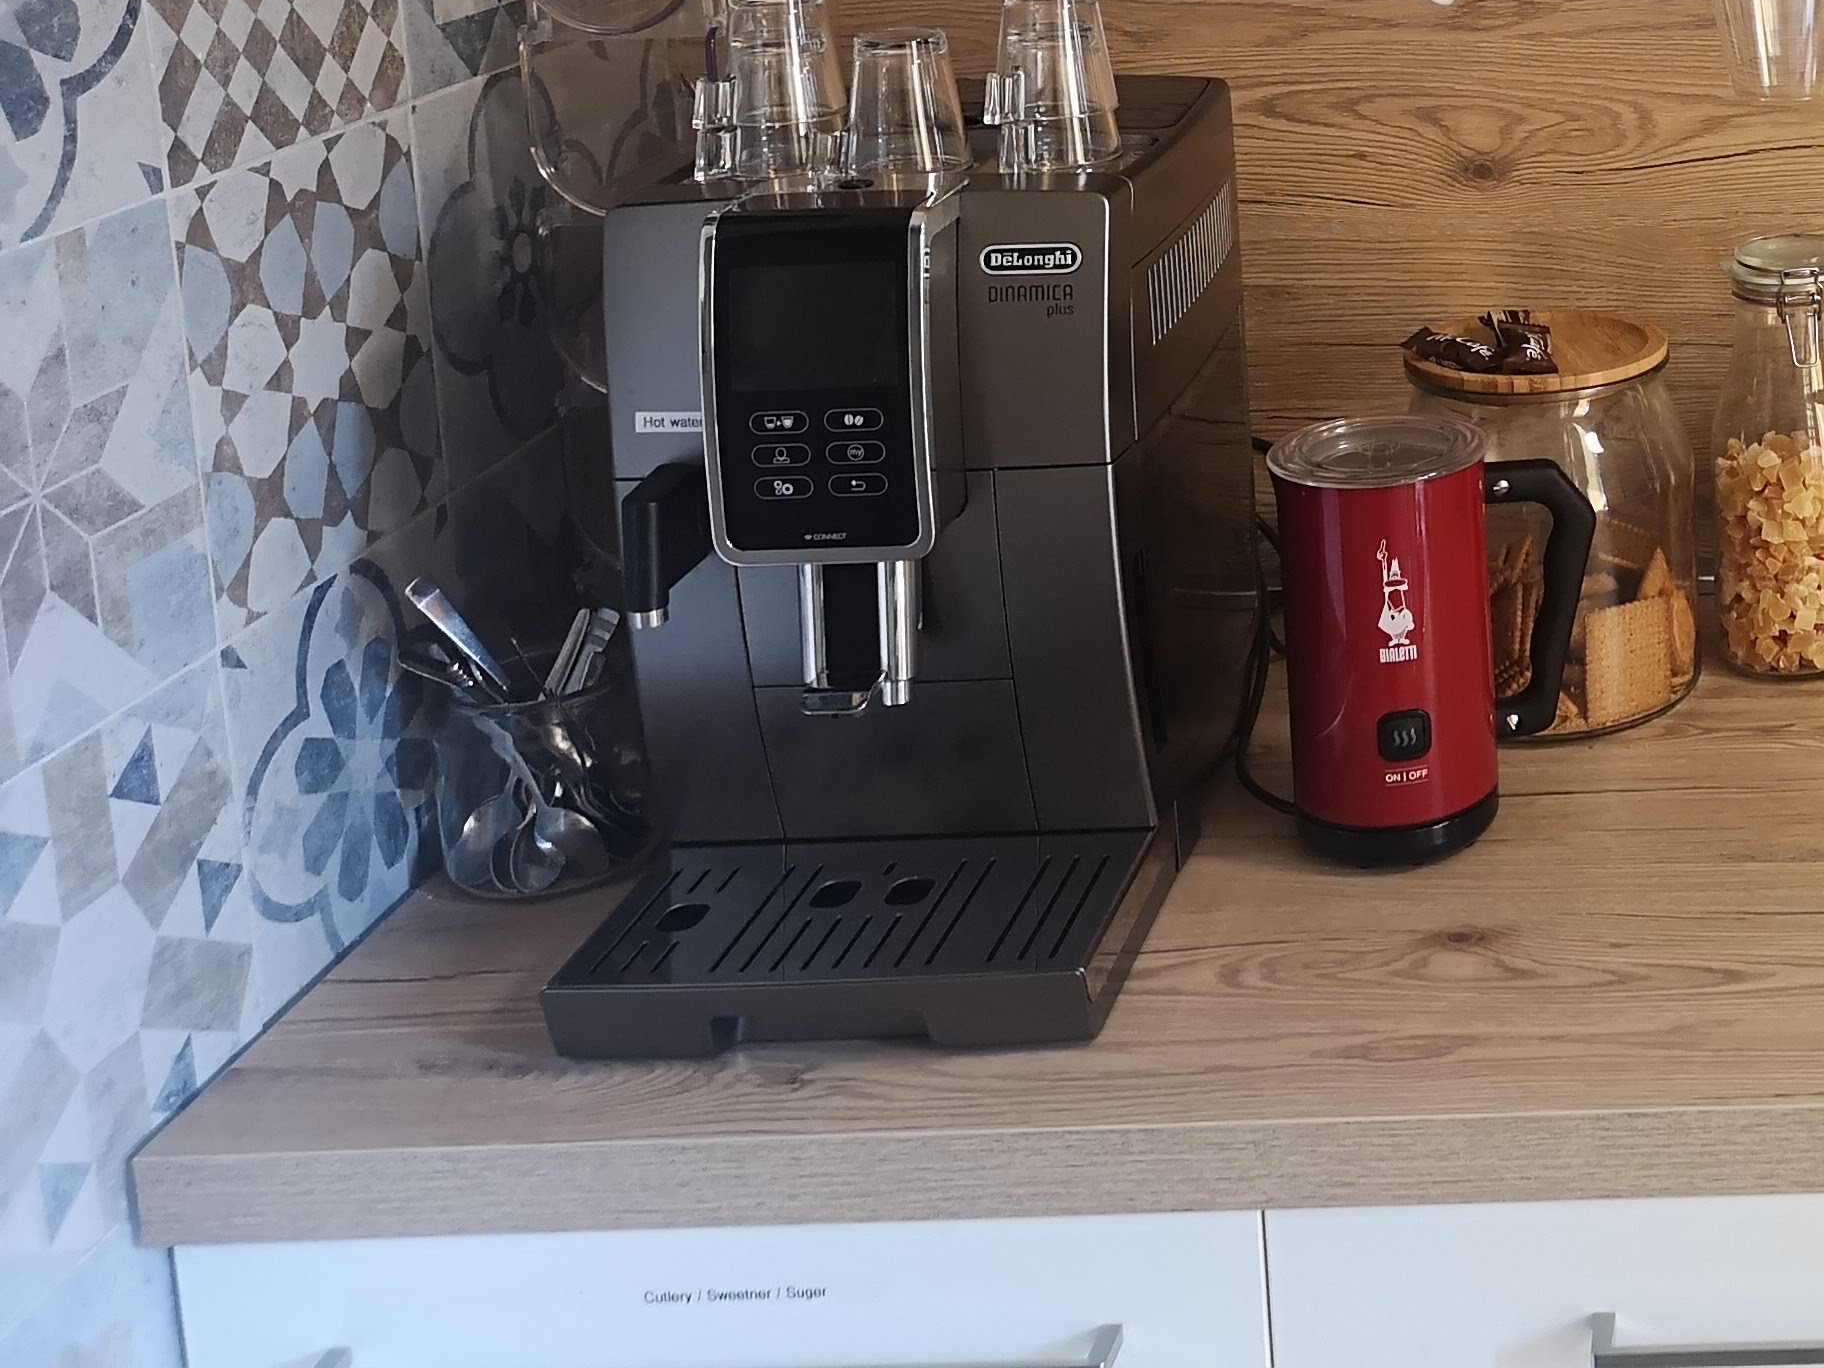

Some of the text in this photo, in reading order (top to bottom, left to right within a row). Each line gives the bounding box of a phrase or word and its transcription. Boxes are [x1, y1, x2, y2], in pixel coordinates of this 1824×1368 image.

[987, 283, 1074, 303] DINAMICA
[1046, 302, 1075, 319] plus
[643, 416, 704, 429] Hot water
[849, 448, 864, 458] my
[813, 532, 848, 541] CONNECT
[1379, 644, 1418, 664] BIALETTI
[1385, 772, 1401, 784] ON
[1408, 768, 1429, 781] OFF
[643, 1289, 693, 1305] Cutlery
[706, 1287, 772, 1302] Sweetner
